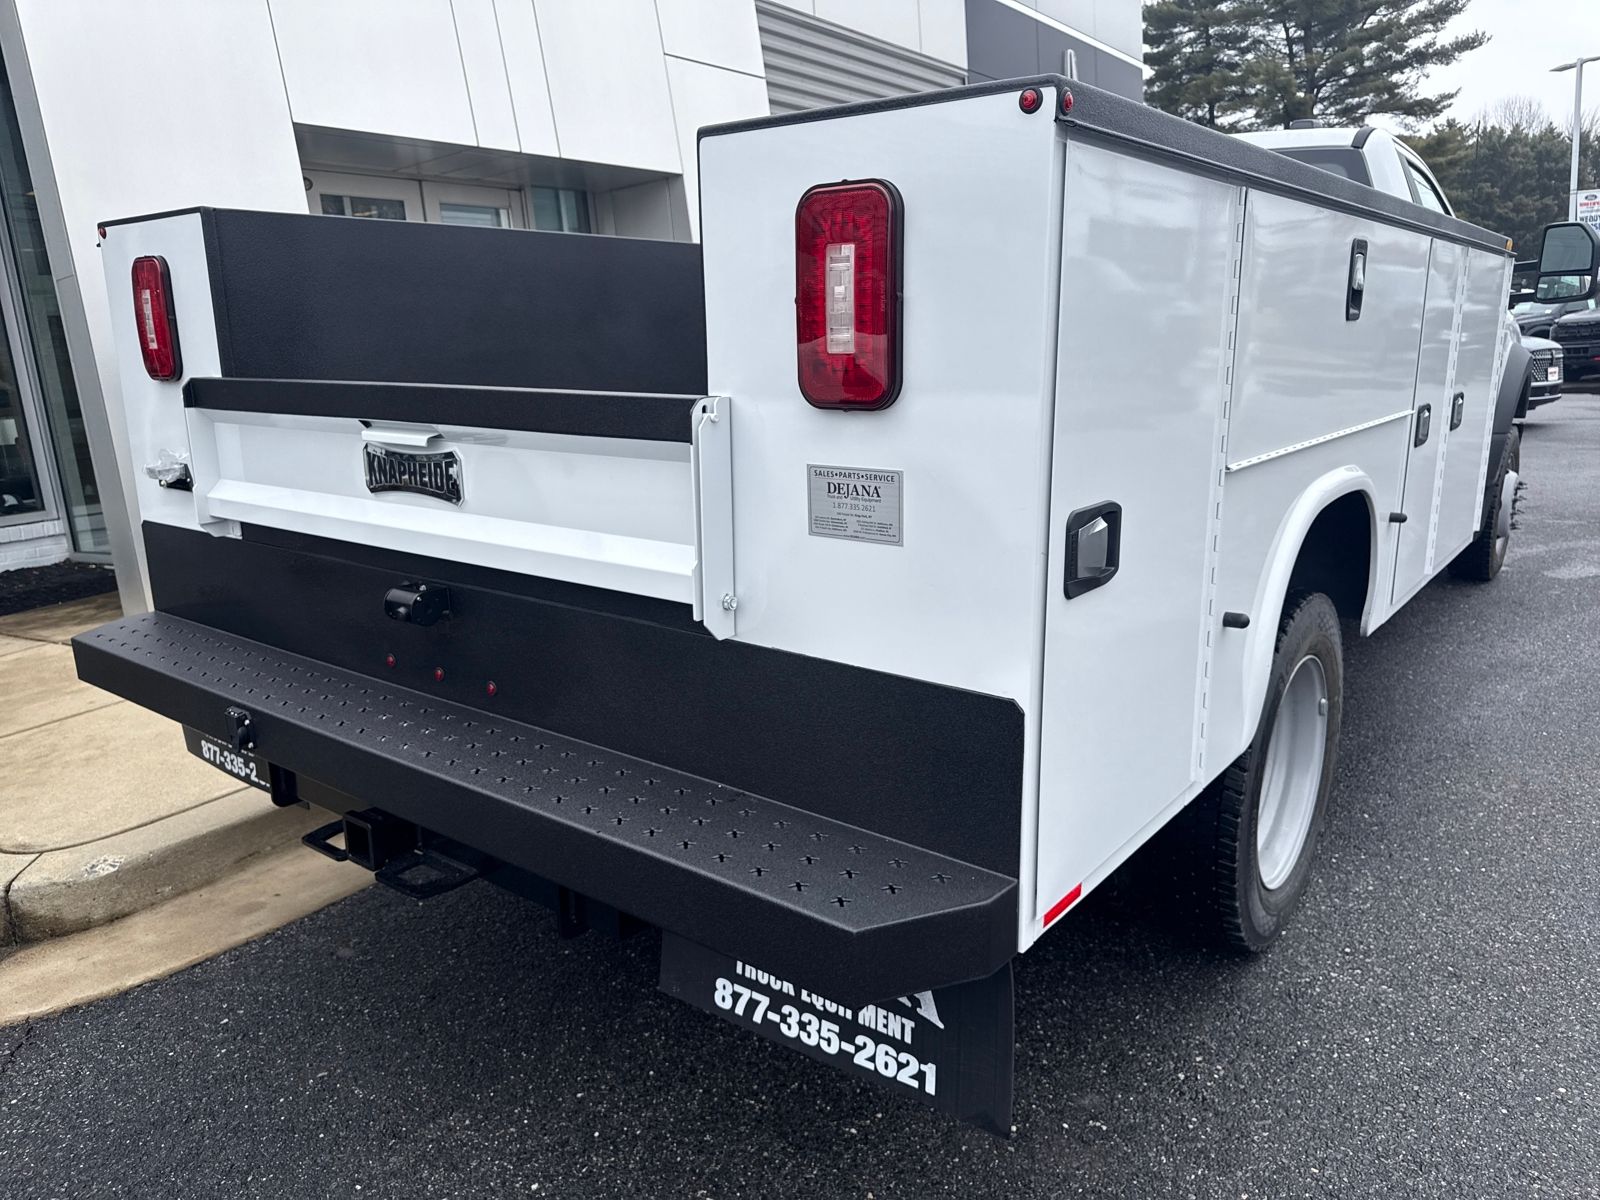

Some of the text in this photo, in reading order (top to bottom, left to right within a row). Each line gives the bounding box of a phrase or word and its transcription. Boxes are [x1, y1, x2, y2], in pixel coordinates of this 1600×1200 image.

[367, 452, 458, 498] KNAPHEIDE
[814, 469, 895, 482] SALES PARTS SERVICE
[827, 481, 881, 499] DEJANA
[201, 739, 271, 788] 877-335-2
[714, 977, 937, 1096] 877-335-2621
